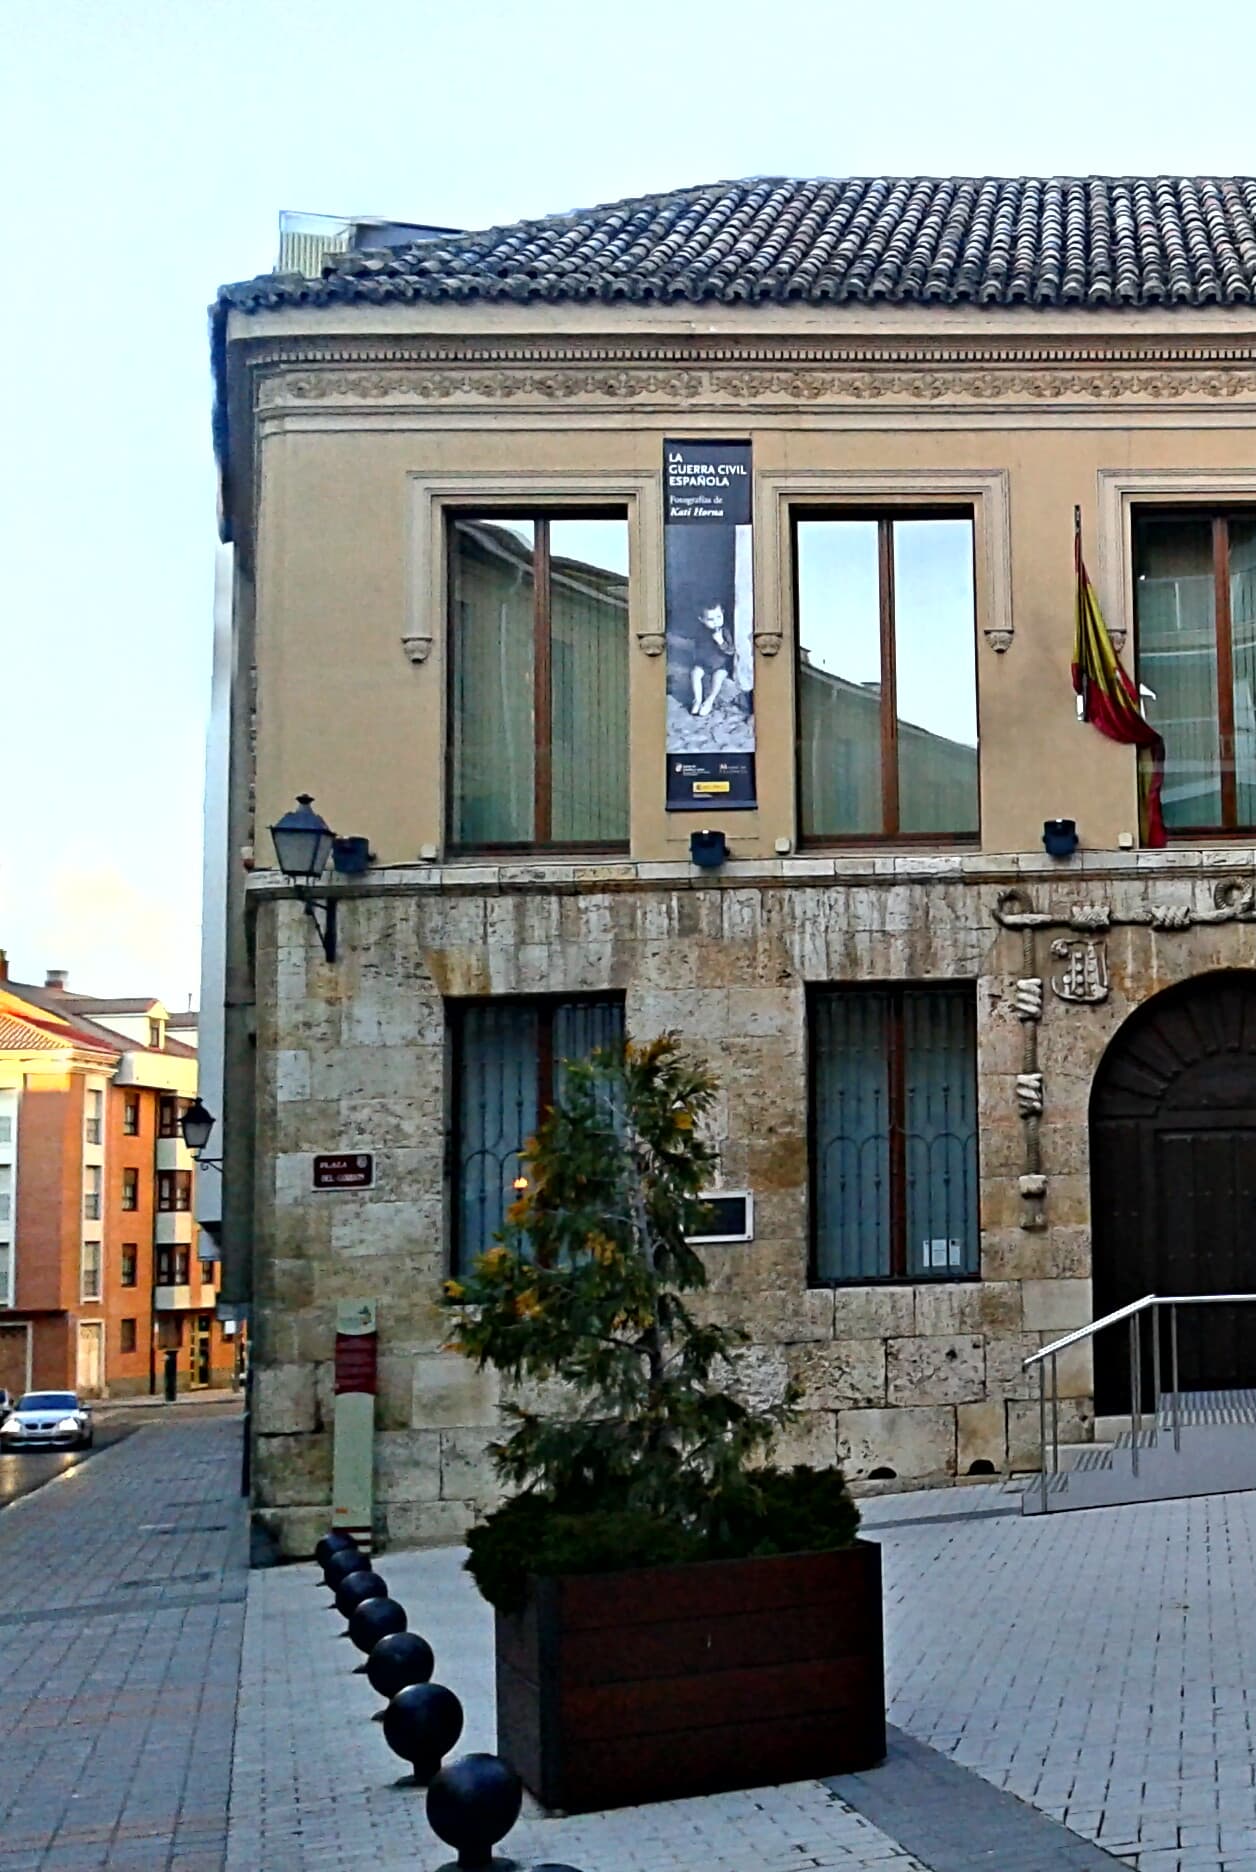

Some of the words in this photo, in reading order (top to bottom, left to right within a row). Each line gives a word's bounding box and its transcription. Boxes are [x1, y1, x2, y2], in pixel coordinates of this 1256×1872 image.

[669, 453, 683, 463] LA
[669, 464, 715, 475] GUERRA
[718, 464, 747, 475] CIVIL
[669, 475, 730, 487] ESPAÑOLA
[713, 496, 723, 504] de
[670, 507, 692, 517] Kati
[694, 507, 724, 517] Horna
